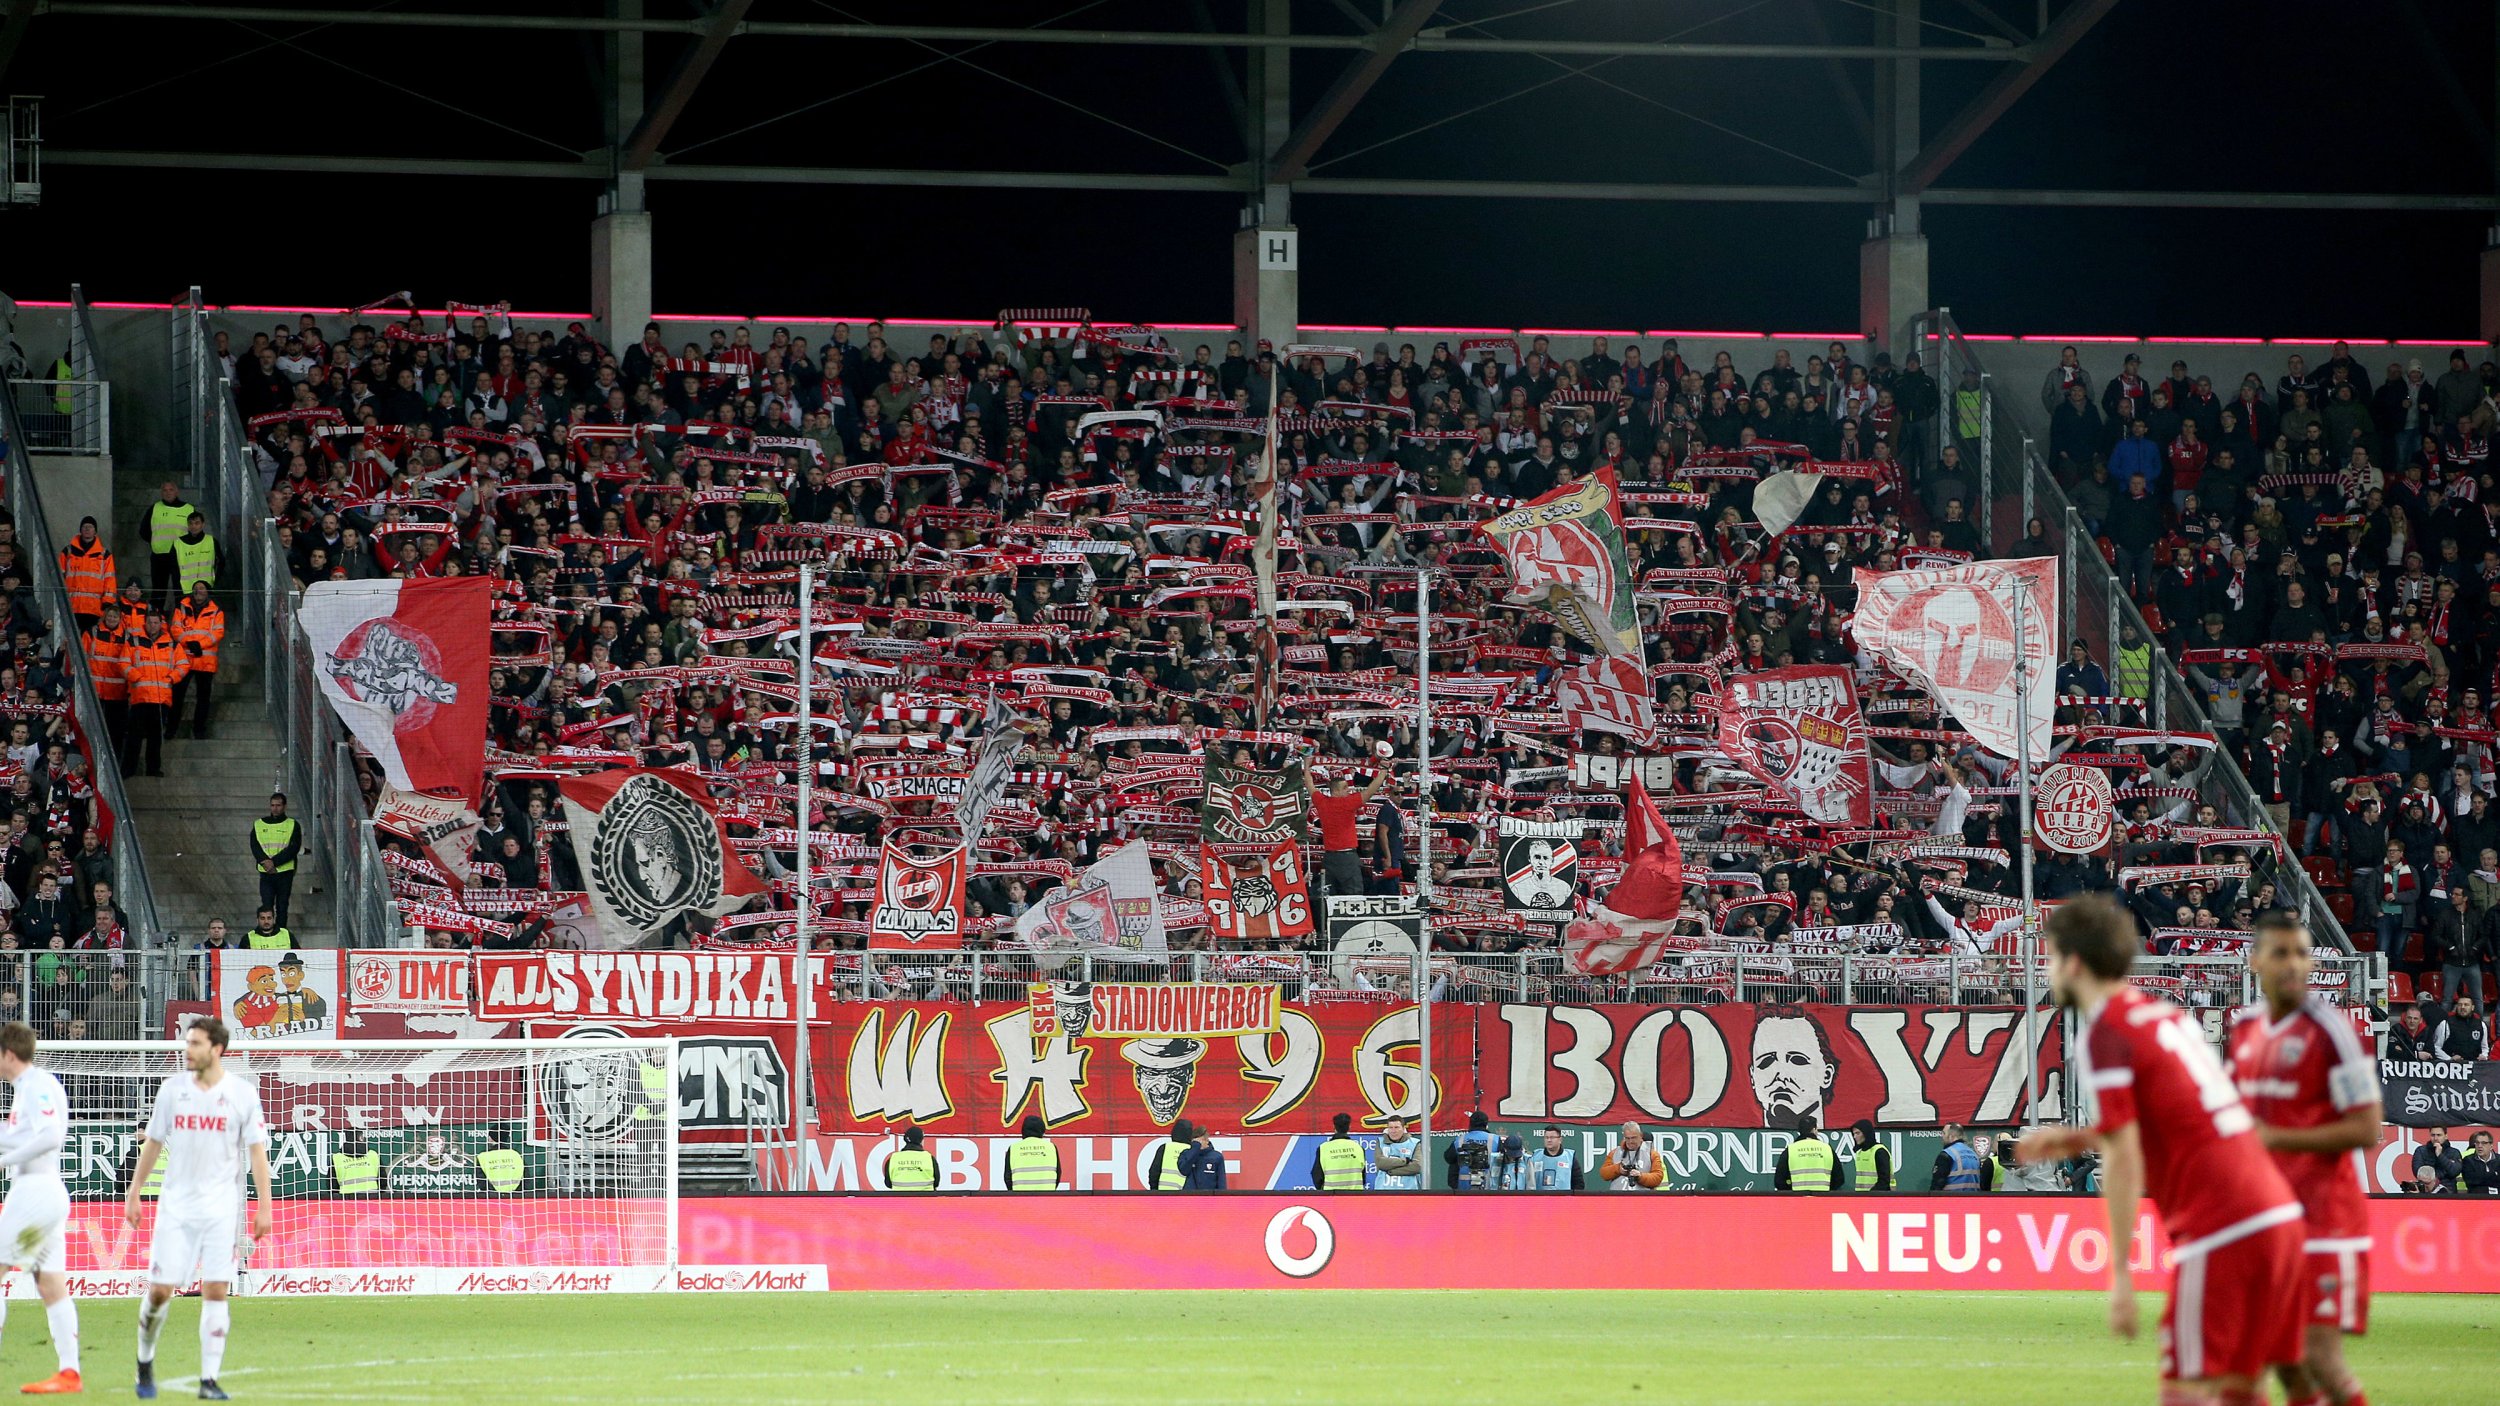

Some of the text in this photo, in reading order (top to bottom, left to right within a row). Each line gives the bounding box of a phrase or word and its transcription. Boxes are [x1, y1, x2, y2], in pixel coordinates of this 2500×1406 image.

[1269, 239, 1287, 262] H
[474, 431, 503, 441] KÖLN
[854, 466, 885, 478] 1.FC KÖLN
[1684, 468, 1753, 477] FC KÖLN
[1619, 480, 1648, 488] KING
[1646, 494, 1671, 502] ON
[1306, 514, 1393, 524] UNSERE LIEBE
[1020, 526, 1068, 536] FEBRUAR
[1240, 538, 1254, 547] FC
[1201, 566, 1238, 575] IMMER 1.FC
[1667, 570, 1692, 578] IMMER
[762, 607, 789, 616] SUPER
[1676, 600, 1700, 610] IMMER
[1401, 640, 1414, 648] FÜR
[2223, 649, 2248, 661] FC
[711, 657, 789, 670] FÜR IMMER 1.FC KÖLN
[988, 672, 1004, 680] FC
[1029, 685, 1111, 701] FÜR IMMER KÖLN
[1467, 704, 1504, 716] KÖLN
[1691, 714, 1707, 724] 51
[570, 719, 598, 733] FC KÖLN
[1254, 732, 1293, 743] 1948
[1138, 756, 1153, 764] FÜR
[1154, 756, 1179, 764] IMMER
[1457, 758, 1498, 766] KÖLN
[2098, 756, 2138, 764] KÖLN
[1116, 765, 1198, 788] FÜR IMMER 1.FC KÖLN
[1218, 768, 1286, 790] WILDE
[1173, 788, 1189, 797] FÜR
[385, 791, 455, 821] Syndikat
[1214, 816, 1297, 842] HORDE
[1500, 816, 1584, 838] DOMINIK
[1767, 828, 1790, 838] FC
[918, 833, 1000, 848] FÜR IMMER KÖLN
[1000, 863, 1024, 871] IMMER
[902, 881, 936, 900] 1.FC
[413, 902, 494, 930] SYNDIKAT
[876, 910, 955, 931] COLONIACS
[1529, 911, 1567, 919] EINER VON
[1792, 927, 1836, 943] BOYZ
[1857, 924, 1902, 938] KÖLN
[707, 938, 723, 947] FÜR
[772, 940, 794, 948] KÖLN
[1730, 941, 1770, 954] BOYZ
[1802, 968, 1841, 982] BOYZ
[2307, 972, 2346, 985] ERLAND
[548, 952, 825, 1019] SYNDIKAT
[1090, 985, 1275, 1035] STADIONVERBOT
[235, 1015, 334, 1040] KRAADE
[2382, 1060, 2473, 1080] RURDORF
[174, 1114, 227, 1132] REWE
[392, 1173, 477, 1187] HERRNBRÄU
[1831, 1212, 2002, 1274] NEU:
[257, 1271, 417, 1295] Media Markt
[457, 1270, 612, 1293] Media Markt
[744, 1270, 808, 1291] Markt
